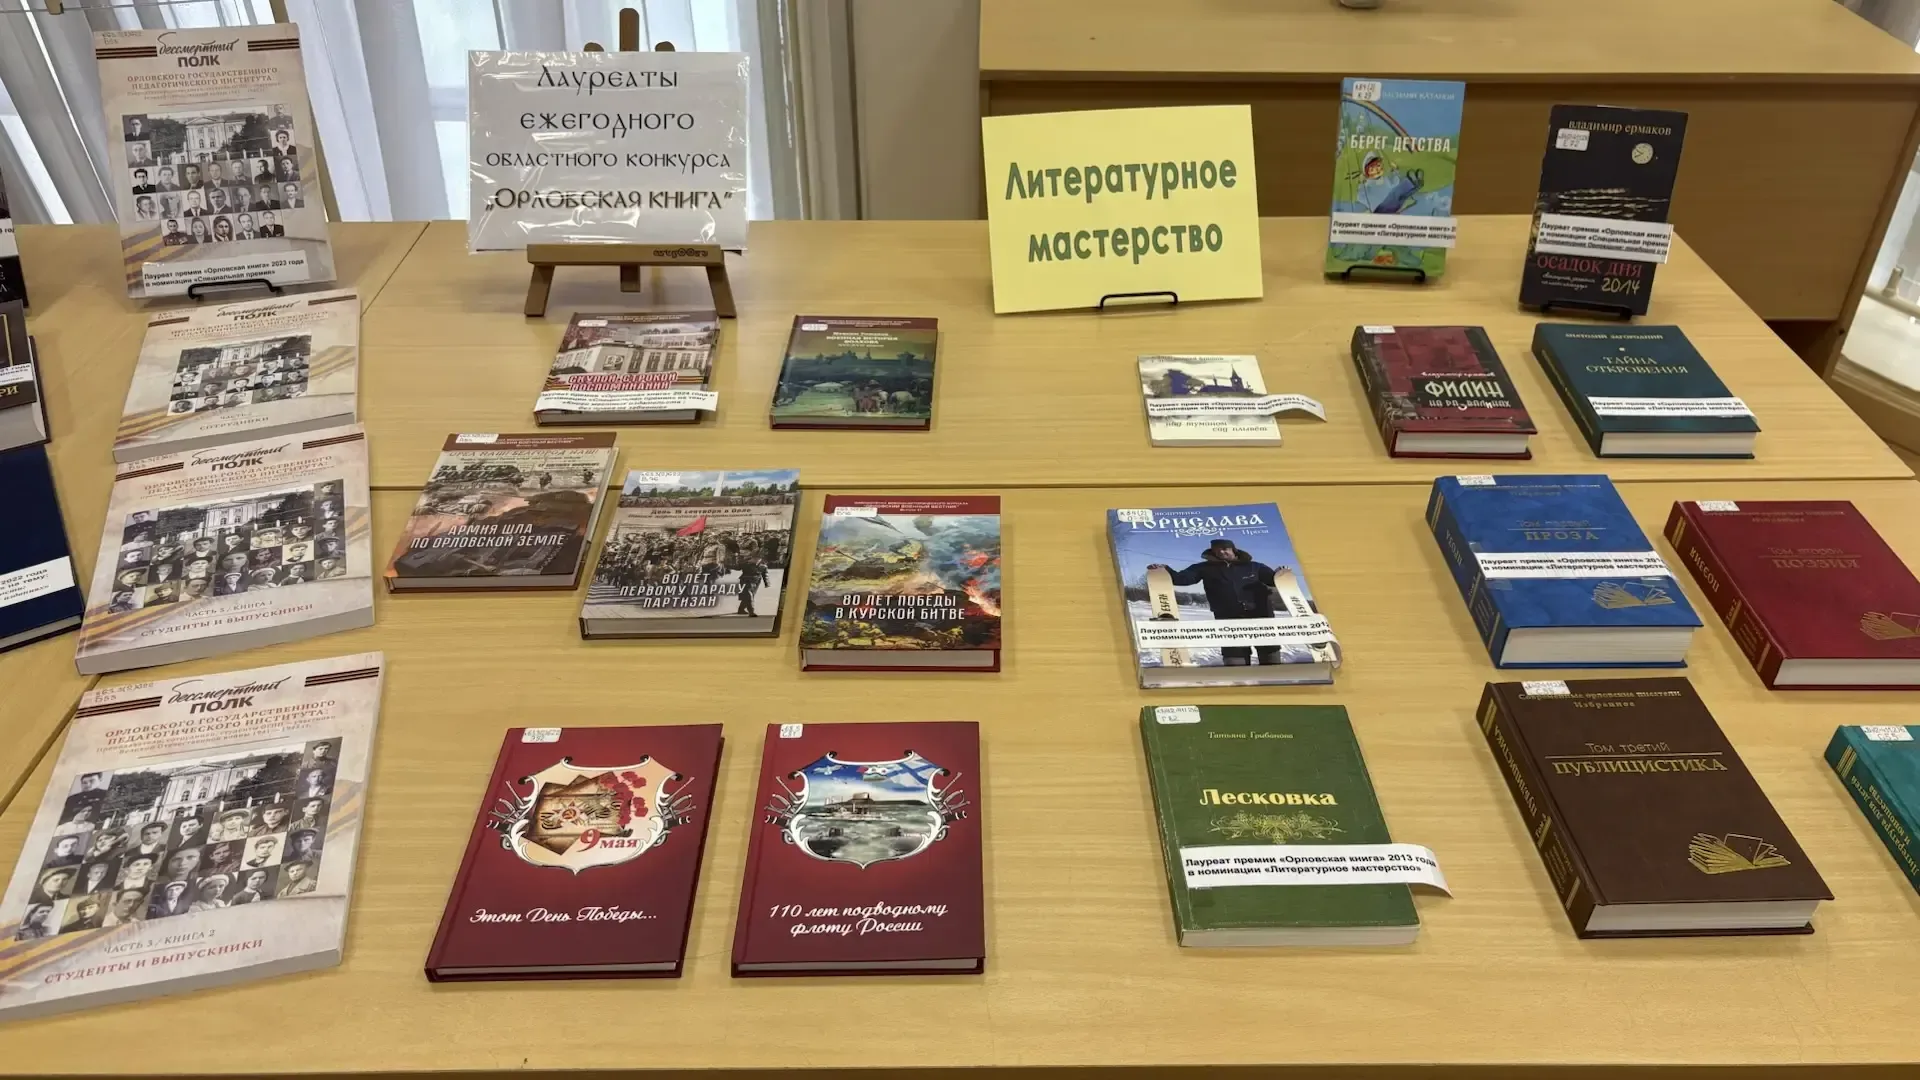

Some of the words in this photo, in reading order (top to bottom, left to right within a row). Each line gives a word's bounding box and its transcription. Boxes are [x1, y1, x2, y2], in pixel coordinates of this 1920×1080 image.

[157, 32, 239, 55] бессмертный
[177, 54, 220, 68] ПОЛК
[127, 73, 185, 83] ОРЛОВСКОГО
[187, 67, 278, 79] ГОСУДАРСТВЕННОГО
[537, 64, 677, 96] Лауреаты
[132, 78, 218, 90] ПЕДАГОГИЧЕСКОГО
[1568, 120, 1623, 134] владимир
[1625, 124, 1672, 136] ермаков
[1350, 134, 1389, 150] БЕРЕГ
[1392, 136, 1451, 153] ДЕТСТВА
[1005, 159, 1237, 204] Литературное
[1333, 220, 1359, 229] Лауреат
[1541, 222, 1570, 232] Лауреат
[1572, 225, 1600, 234] премии
[1028, 223, 1223, 265] мастерство
[144, 271, 174, 281] Лауреат
[175, 268, 202, 278] премии
[203, 264, 246, 275] «Орловская
[271, 259, 287, 267] 2023
[288, 258, 304, 266] года
[151, 278, 192, 288] номинации
[193, 273, 245, 283] «Специальная
[246, 269, 276, 279] премия»
[1601, 278, 1640, 295] 2014
[233, 310, 278, 321] ПОЛК
[1602, 355, 1658, 365] ТАЙНА
[1586, 364, 1688, 374] ОТКРОВЕНИЯ
[1424, 380, 1505, 398] ФИЛИН
[191, 442, 291, 467] бессмертный
[211, 457, 264, 472] ПОЛК
[144, 472, 219, 492] ОРЛОВСКОГО
[448, 524, 499, 536] АРМИЯ
[501, 523, 533, 535] ШЛА
[1131, 513, 1265, 530] ГОРИСЛАВА
[410, 537, 430, 549] ПО
[432, 534, 514, 548] ОРЛОВСКОЙ
[517, 534, 566, 546] ЗЕМЛЕ
[1524, 531, 1600, 541] ПРОЗА
[1480, 559, 1517, 567] Лауреат
[1519, 558, 1555, 566] премии
[1557, 557, 1612, 566] «Орловская
[1546, 563, 1615, 572] «Литературное
[1689, 547, 1720, 593] ПОЭЗИЯ
[1, 575, 23, 585] 2022
[26, 568, 48, 578] года
[661, 574, 682, 584] 80
[683, 573, 711, 584] ЛЕТ
[619, 585, 687, 597] ПЕРВОМУ
[690, 583, 747, 596] ПАРАДУ
[642, 596, 717, 608] ПАРТИЗАН
[842, 595, 862, 606] 80
[865, 595, 891, 606] ЛЕТ
[897, 595, 956, 607] ПОБЕДЫ
[140, 618, 211, 638] СТУДЕНТЫ
[226, 604, 314, 625] ВЫПУСКНИКИ
[835, 608, 844, 619] В
[848, 606, 915, 620] КУРСКОЙ
[920, 608, 965, 620] БИТВЕ
[1140, 627, 1178, 635] Лауреат
[1180, 626, 1216, 635] премии
[1218, 624, 1275, 634] «Орловская
[1277, 623, 1308, 632] книга»
[1149, 633, 1203, 641] номинации
[1205, 632, 1276, 641] «Литературное
[168, 676, 292, 704] бессмертный
[190, 696, 254, 715] ПОЛК
[105, 718, 196, 739] ОРЛОВСКОГО
[198, 700, 336, 725] ГОСУДАРСТВЕННОГО
[107, 721, 241, 746] ПЕДАГОГИЧЕСКОГО
[244, 708, 330, 727] ИНСТИТУТА:
[1207, 731, 1247, 739] Татьяна
[1585, 742, 1615, 753] Том
[1619, 741, 1671, 754] третий
[1552, 758, 1728, 776] ПУБЛИЦИСТИКА
[1199, 788, 1339, 806] Лесковка
[577, 828, 600, 853] 9
[599, 837, 640, 849] мая
[1185, 856, 1231, 869] Лауреат
[1234, 855, 1276, 867] премии
[1279, 853, 1346, 866] «Орловская
[1348, 853, 1386, 863] книга»
[1388, 853, 1414, 862] 2013
[1415, 855, 1437, 868] года
[1187, 869, 1195, 877] в
[1198, 867, 1262, 877] номинации
[1264, 864, 1349, 876] «Литературное
[1351, 863, 1422, 875] мастерство»
[469, 907, 522, 924] Этот
[526, 906, 573, 924] День
[576, 904, 657, 924] Победы...
[769, 903, 803, 919] 110
[804, 905, 840, 918] лет
[842, 900, 948, 918] подводному
[790, 922, 852, 938] флоту
[856, 918, 924, 936] России
[103, 940, 145, 955] ЧАСТЬ
[163, 931, 206, 945] КНИГА
[44, 960, 132, 985] СТУДЕНТЫ
[135, 958, 147, 969] И
[151, 938, 264, 967] ВЫПУСКНИКИ
